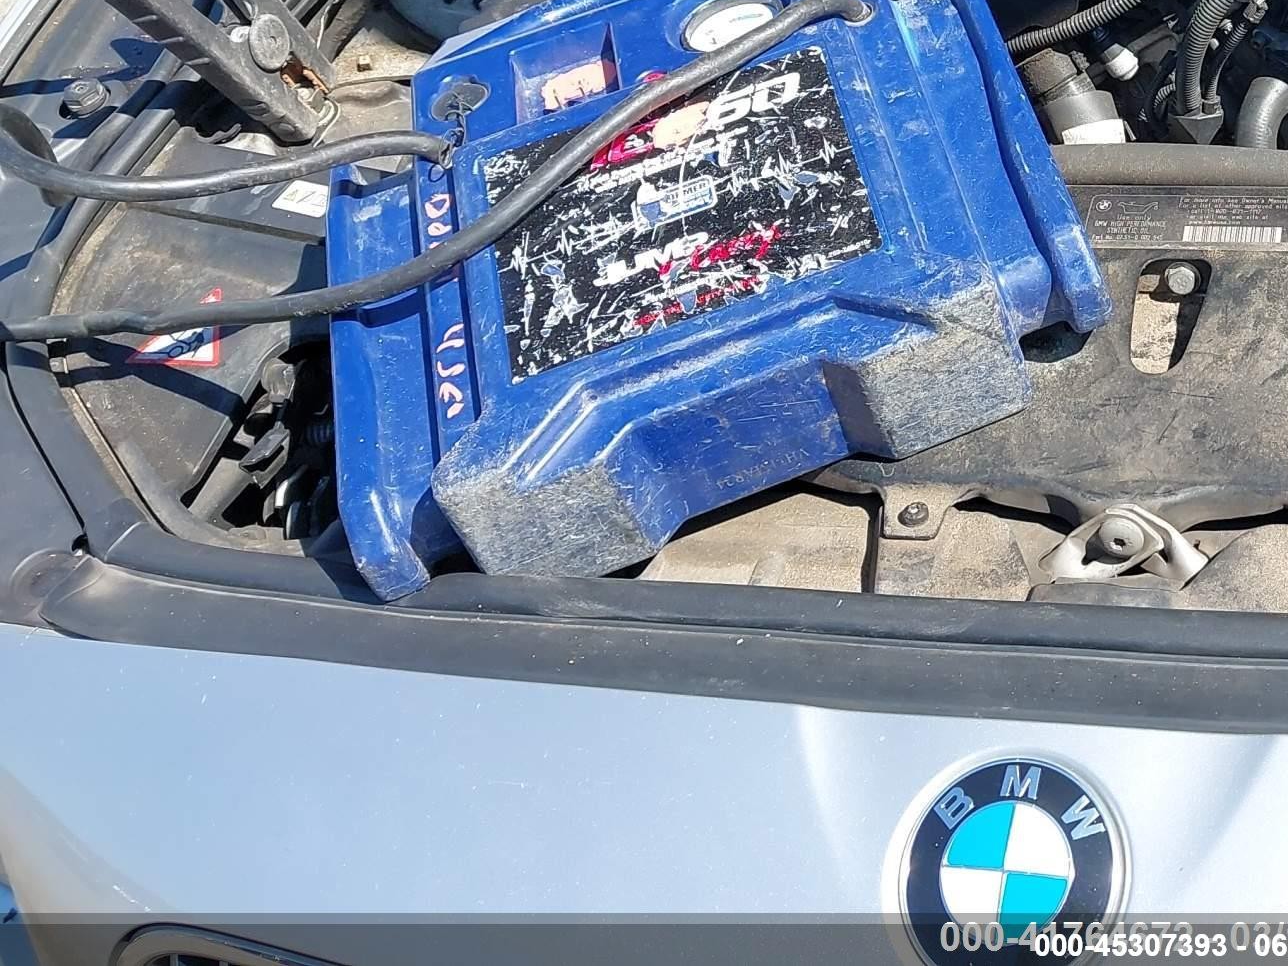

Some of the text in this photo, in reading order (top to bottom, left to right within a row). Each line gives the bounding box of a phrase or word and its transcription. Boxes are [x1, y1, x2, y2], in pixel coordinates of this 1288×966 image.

[1241, 197, 1265, 205] Owner's
[1126, 221, 1167, 229] PERFORMANCE
[933, 764, 1106, 841] BMW
